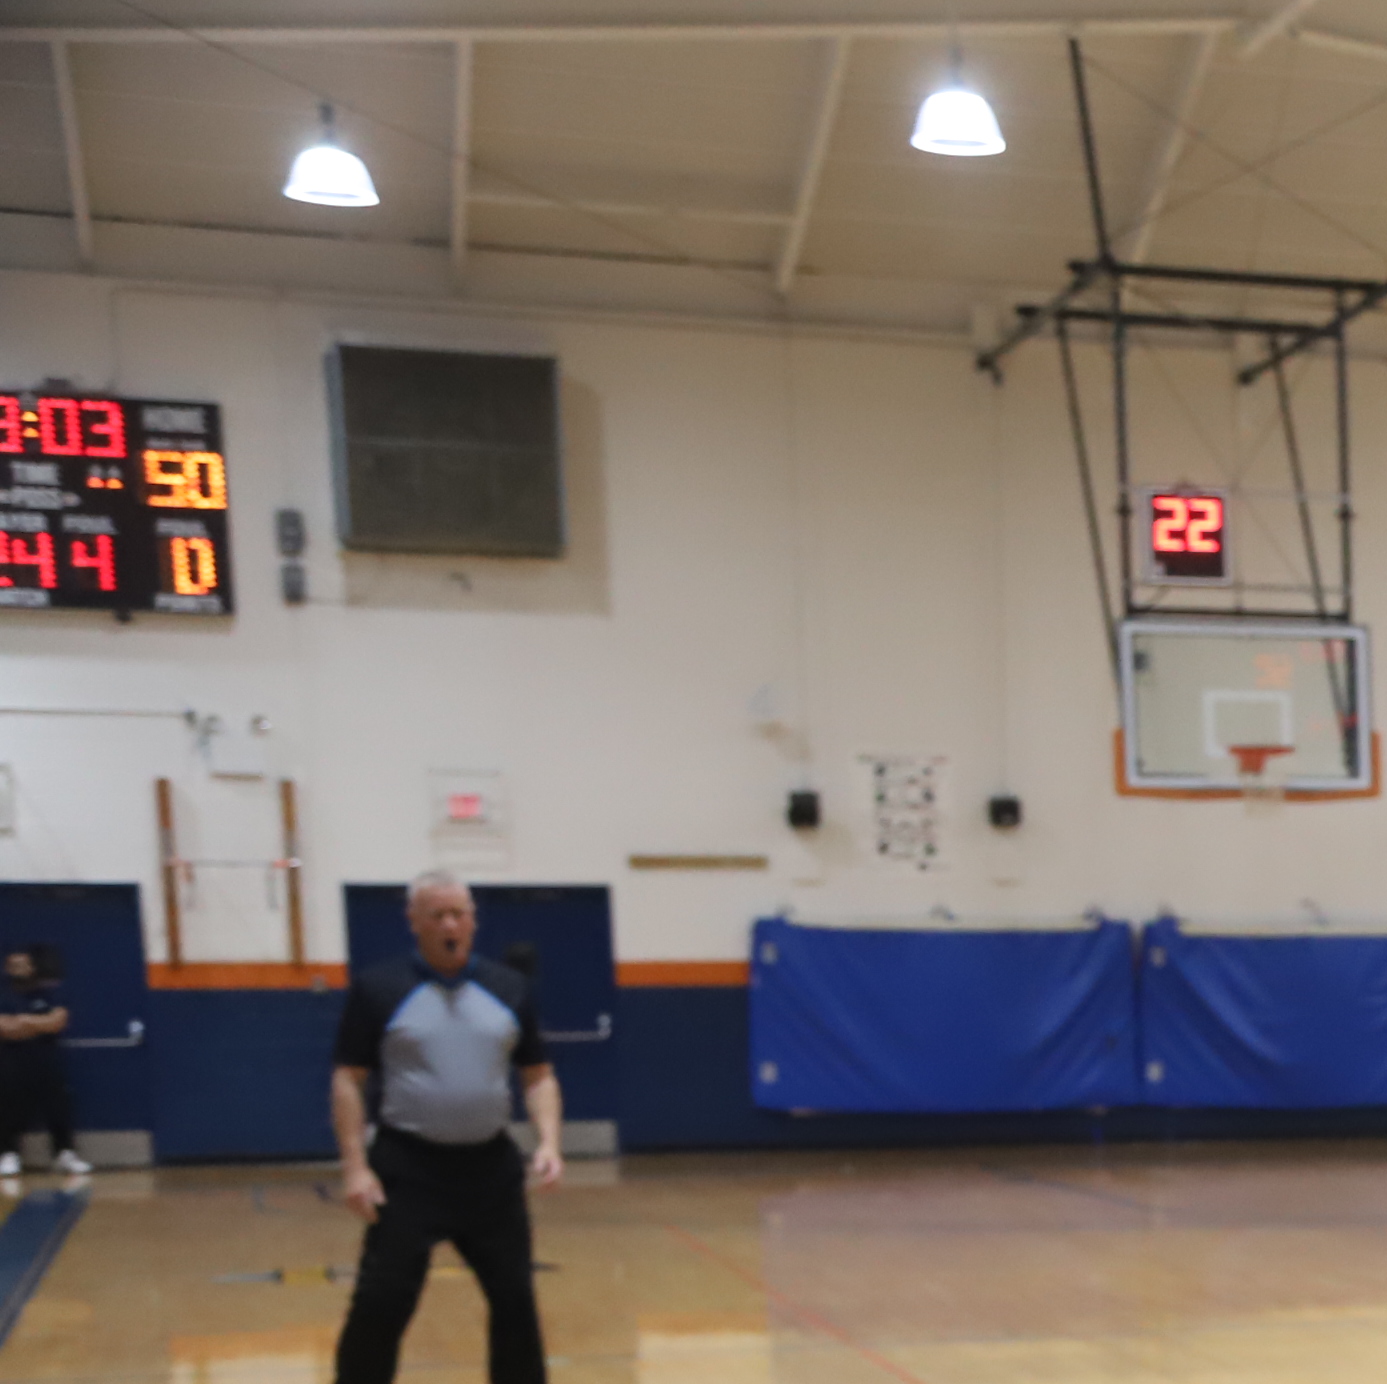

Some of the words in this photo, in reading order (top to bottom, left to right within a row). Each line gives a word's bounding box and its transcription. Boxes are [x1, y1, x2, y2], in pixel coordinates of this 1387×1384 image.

[142, 449, 228, 511] 50
[1152, 496, 1223, 553] 22
[0, 530, 58, 590] 4
[70, 534, 118, 592] 4
[170, 535, 218, 596] 0
